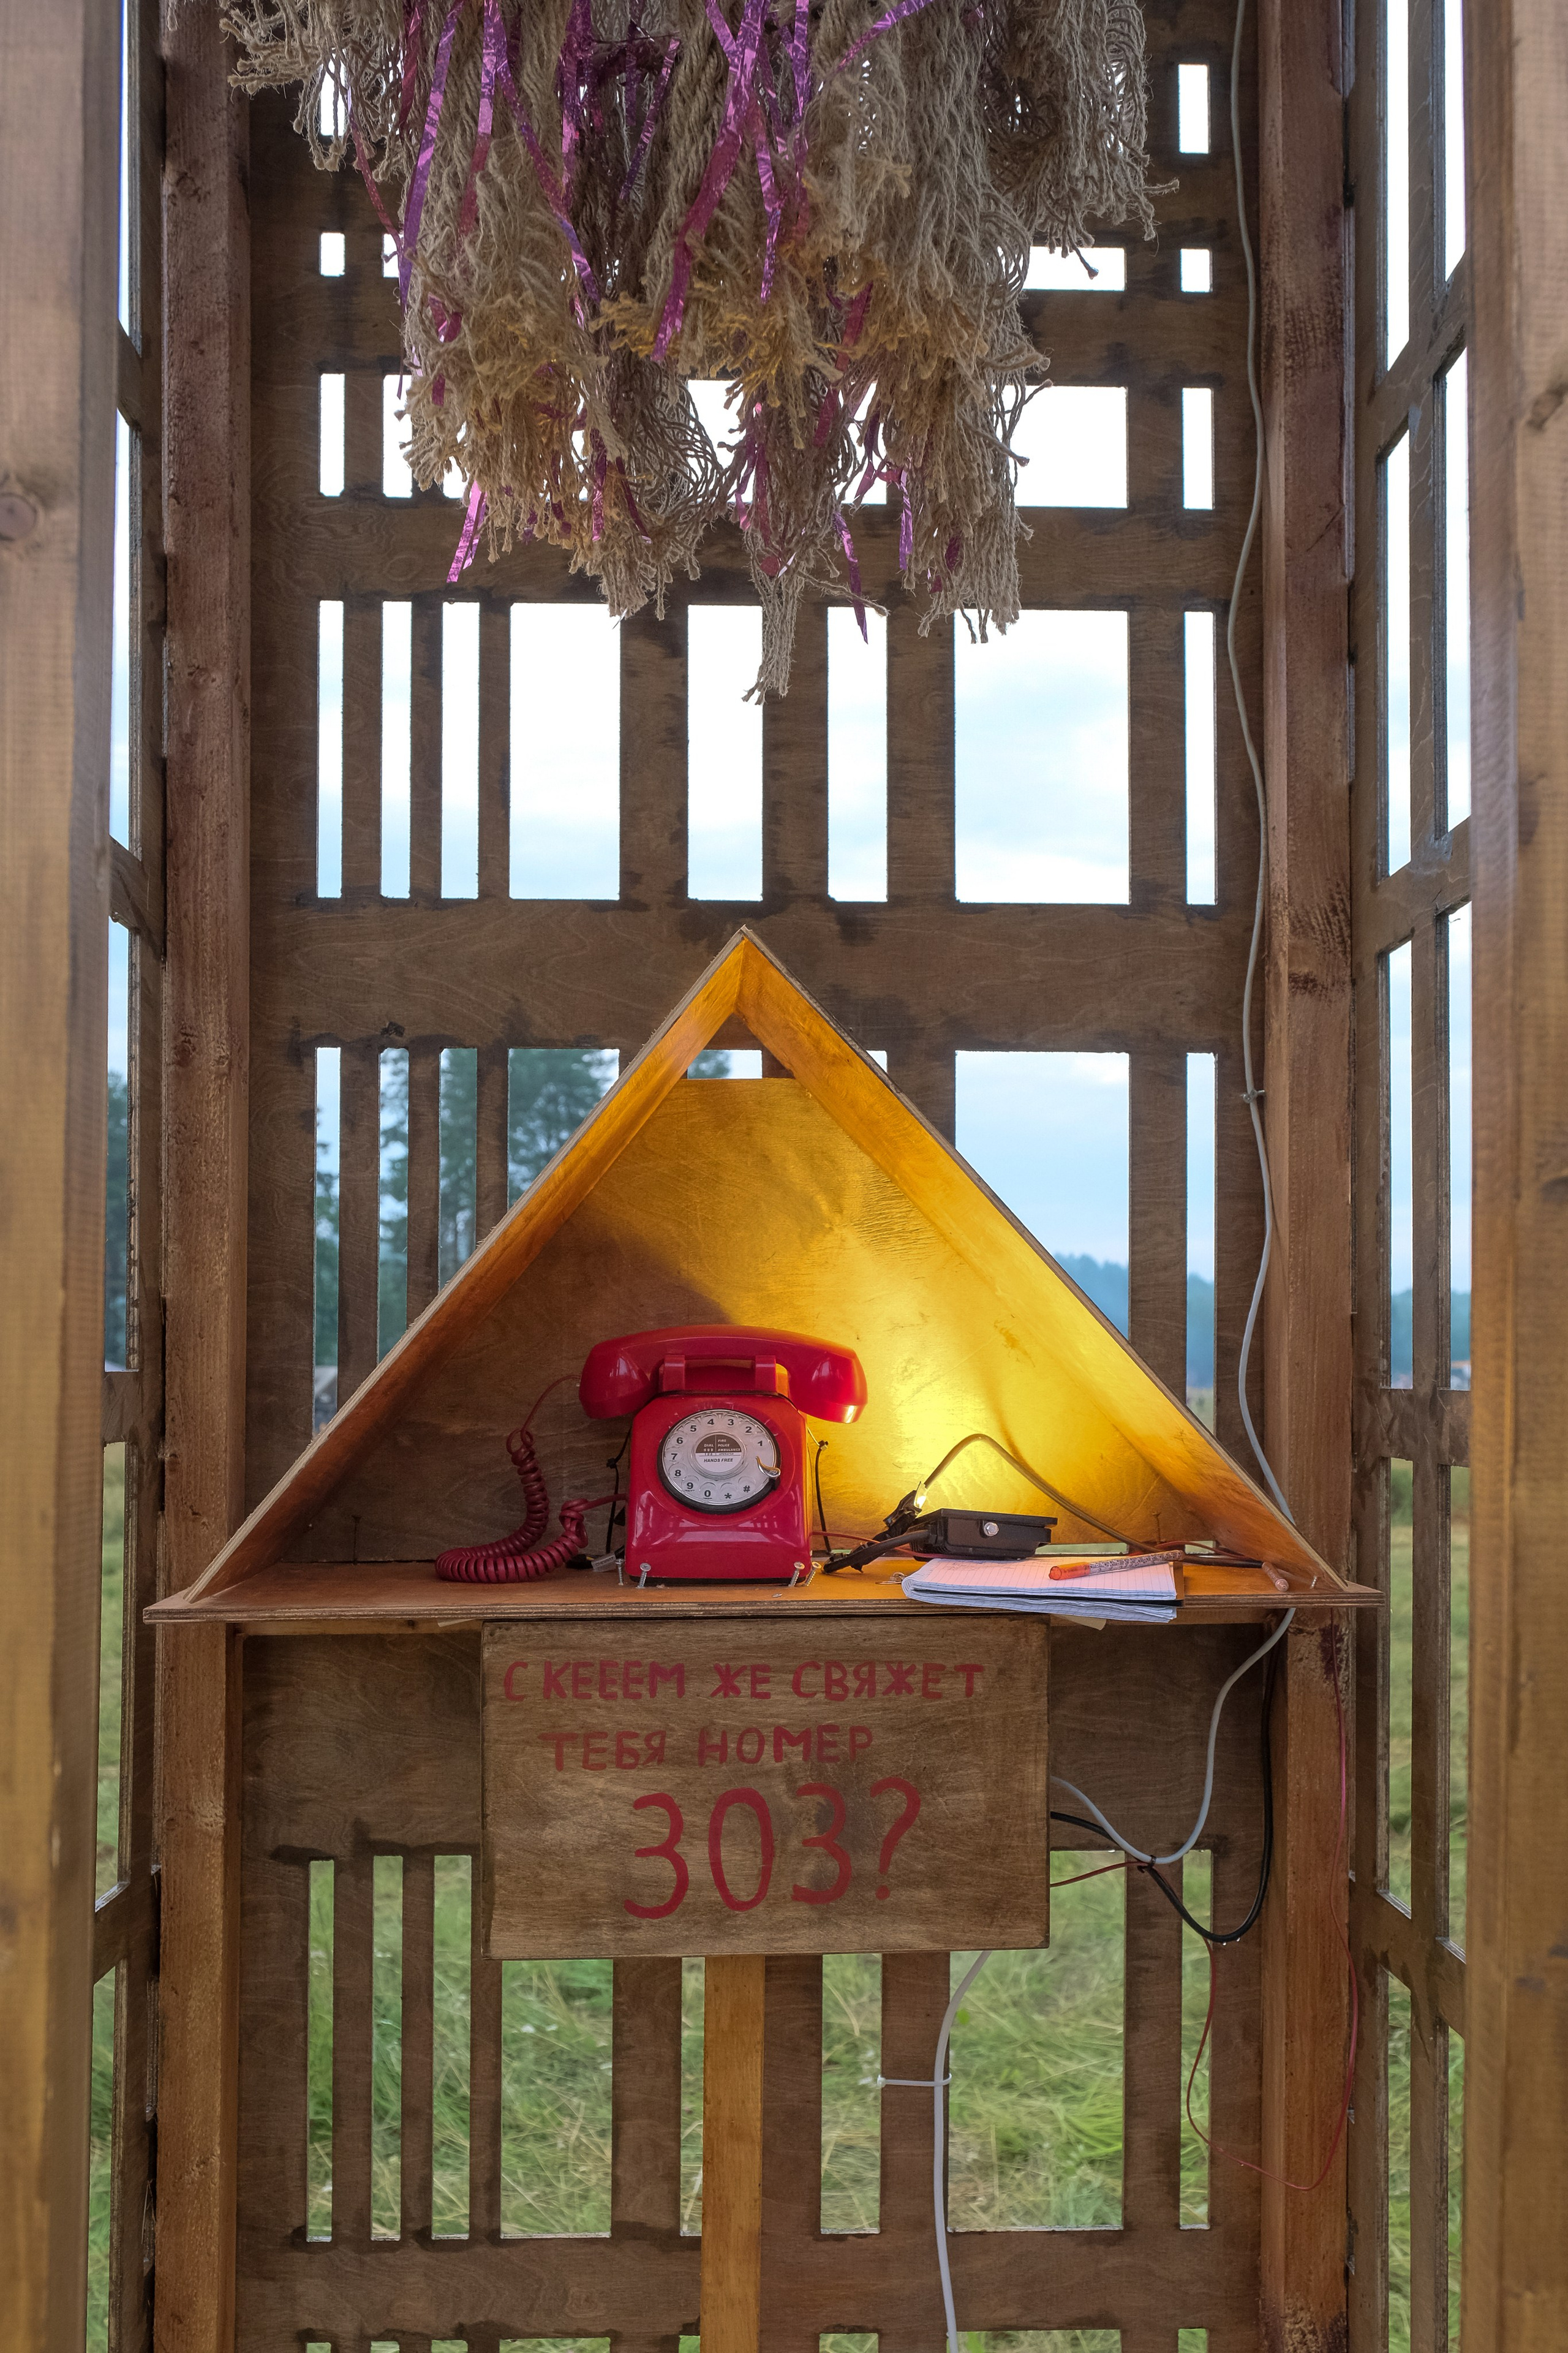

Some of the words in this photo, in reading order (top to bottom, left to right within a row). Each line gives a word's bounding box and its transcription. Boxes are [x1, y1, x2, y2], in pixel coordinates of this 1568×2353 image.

[503, 1661, 529, 1702] С
[543, 1660, 686, 1700] КЕЕЕМ
[709, 1662, 773, 1700] ЖЕ
[791, 1660, 985, 1702] СВЯЖЕТ
[538, 1729, 668, 1772] ТЕБЯ
[697, 1724, 873, 1767] НОМЕР
[623, 1777, 922, 1920] 303?
